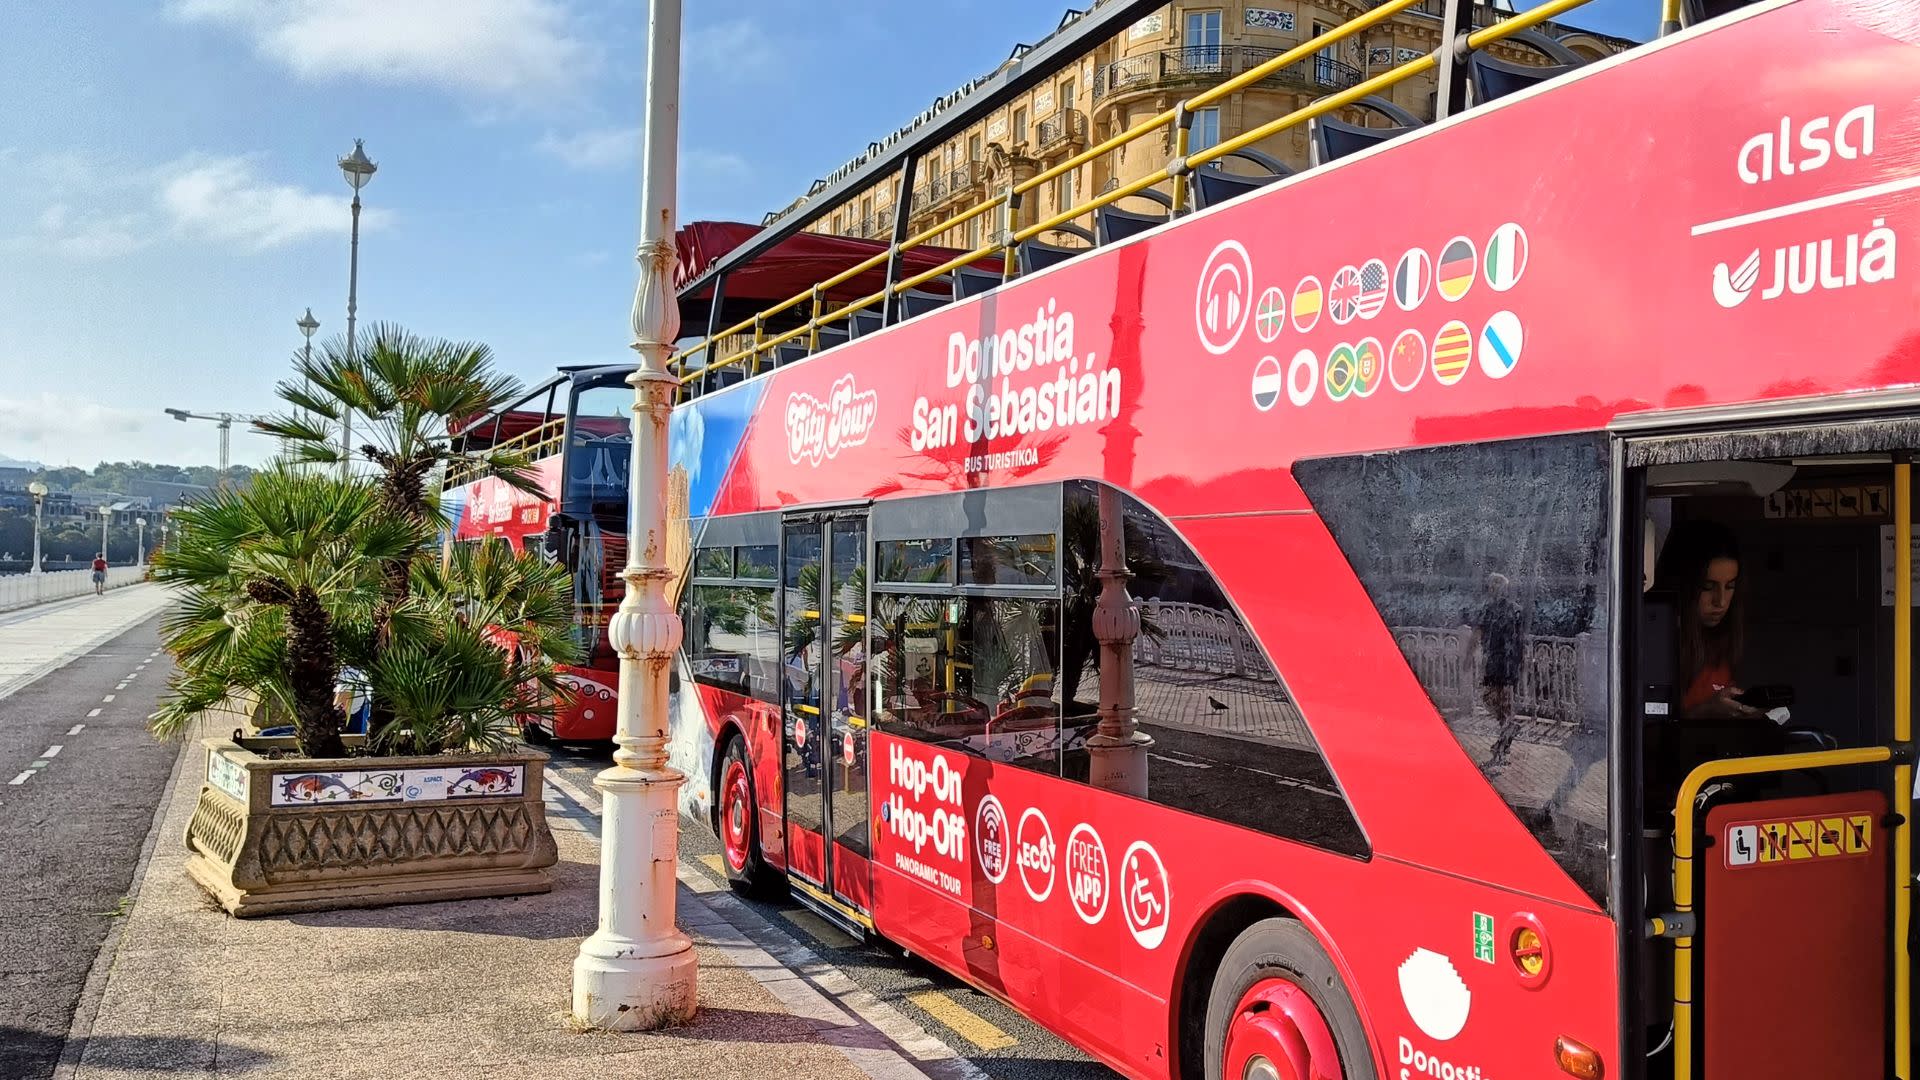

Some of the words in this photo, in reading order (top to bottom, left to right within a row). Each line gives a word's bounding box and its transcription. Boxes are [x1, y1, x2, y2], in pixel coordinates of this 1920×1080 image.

[1737, 104, 1875, 184] alsa
[947, 297, 1075, 388] Donostia
[788, 401, 826, 450] City
[829, 384, 874, 440] Tour
[911, 396, 958, 451] San
[964, 352, 1121, 443] Sebastián
[964, 456, 984, 473] BUS
[984, 447, 1039, 471] TURISTIKOA
[890, 743, 962, 807] Hop-On
[890, 792, 965, 861] Hop-Off
[983, 840, 1002, 857] FREE
[895, 852, 938, 884] PANORAMIC
[939, 874, 962, 897] TOUR
[1022, 843, 1051, 874] ECO
[1072, 838, 1101, 877] FREE
[1074, 876, 1101, 907] APP
[1398, 1035, 1490, 1080] Donosti
